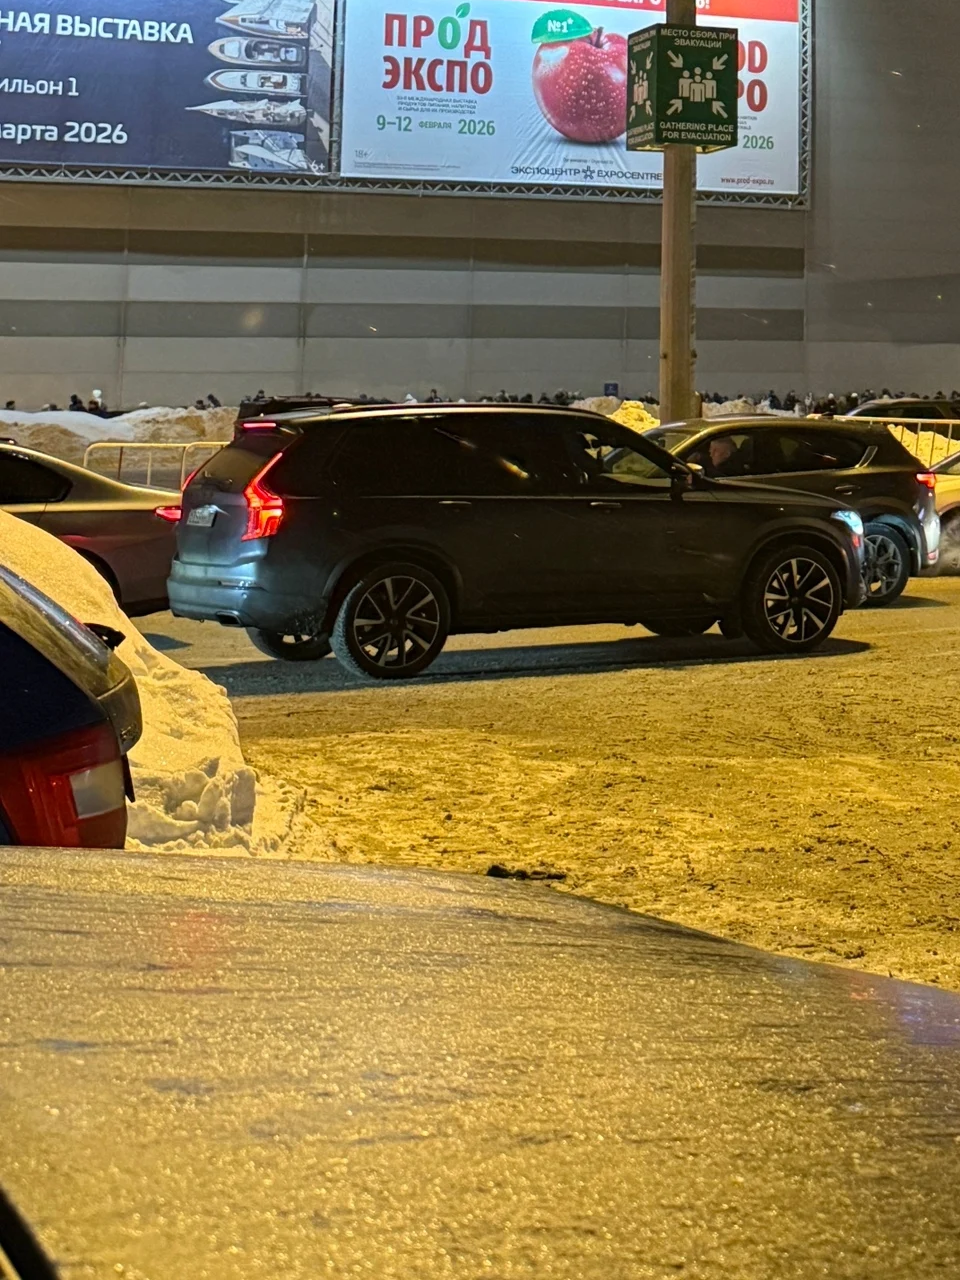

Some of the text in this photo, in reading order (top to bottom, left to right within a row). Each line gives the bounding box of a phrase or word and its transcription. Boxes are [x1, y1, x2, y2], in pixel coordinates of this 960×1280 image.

[56, 14, 194, 44] ВЫСТАВКА
[384, 12, 492, 60] ПРОД
[661, 28, 736, 40] МЕСТО СБОРА ПРИ
[674, 38, 722, 48] ЭВАКУАЦИИ
[382, 55, 493, 95] ЭКСПО
[68, 77, 79, 96] 1
[0, 121, 128, 145] арта 2026
[419, 120, 452, 129] ФЕВРАЛЯ
[458, 119, 496, 136] 2026
[660, 121, 706, 131] GATHERING
[708, 124, 734, 132] PLACE
[662, 131, 679, 139] FOR
[681, 131, 731, 141] EVACUATION
[742, 134, 774, 150] 2026
[312, 160, 325, 170] 6+
[511, 166, 580, 177] ЭКСПОЦЕНТР
[597, 170, 663, 180] EXPOCENTRE
